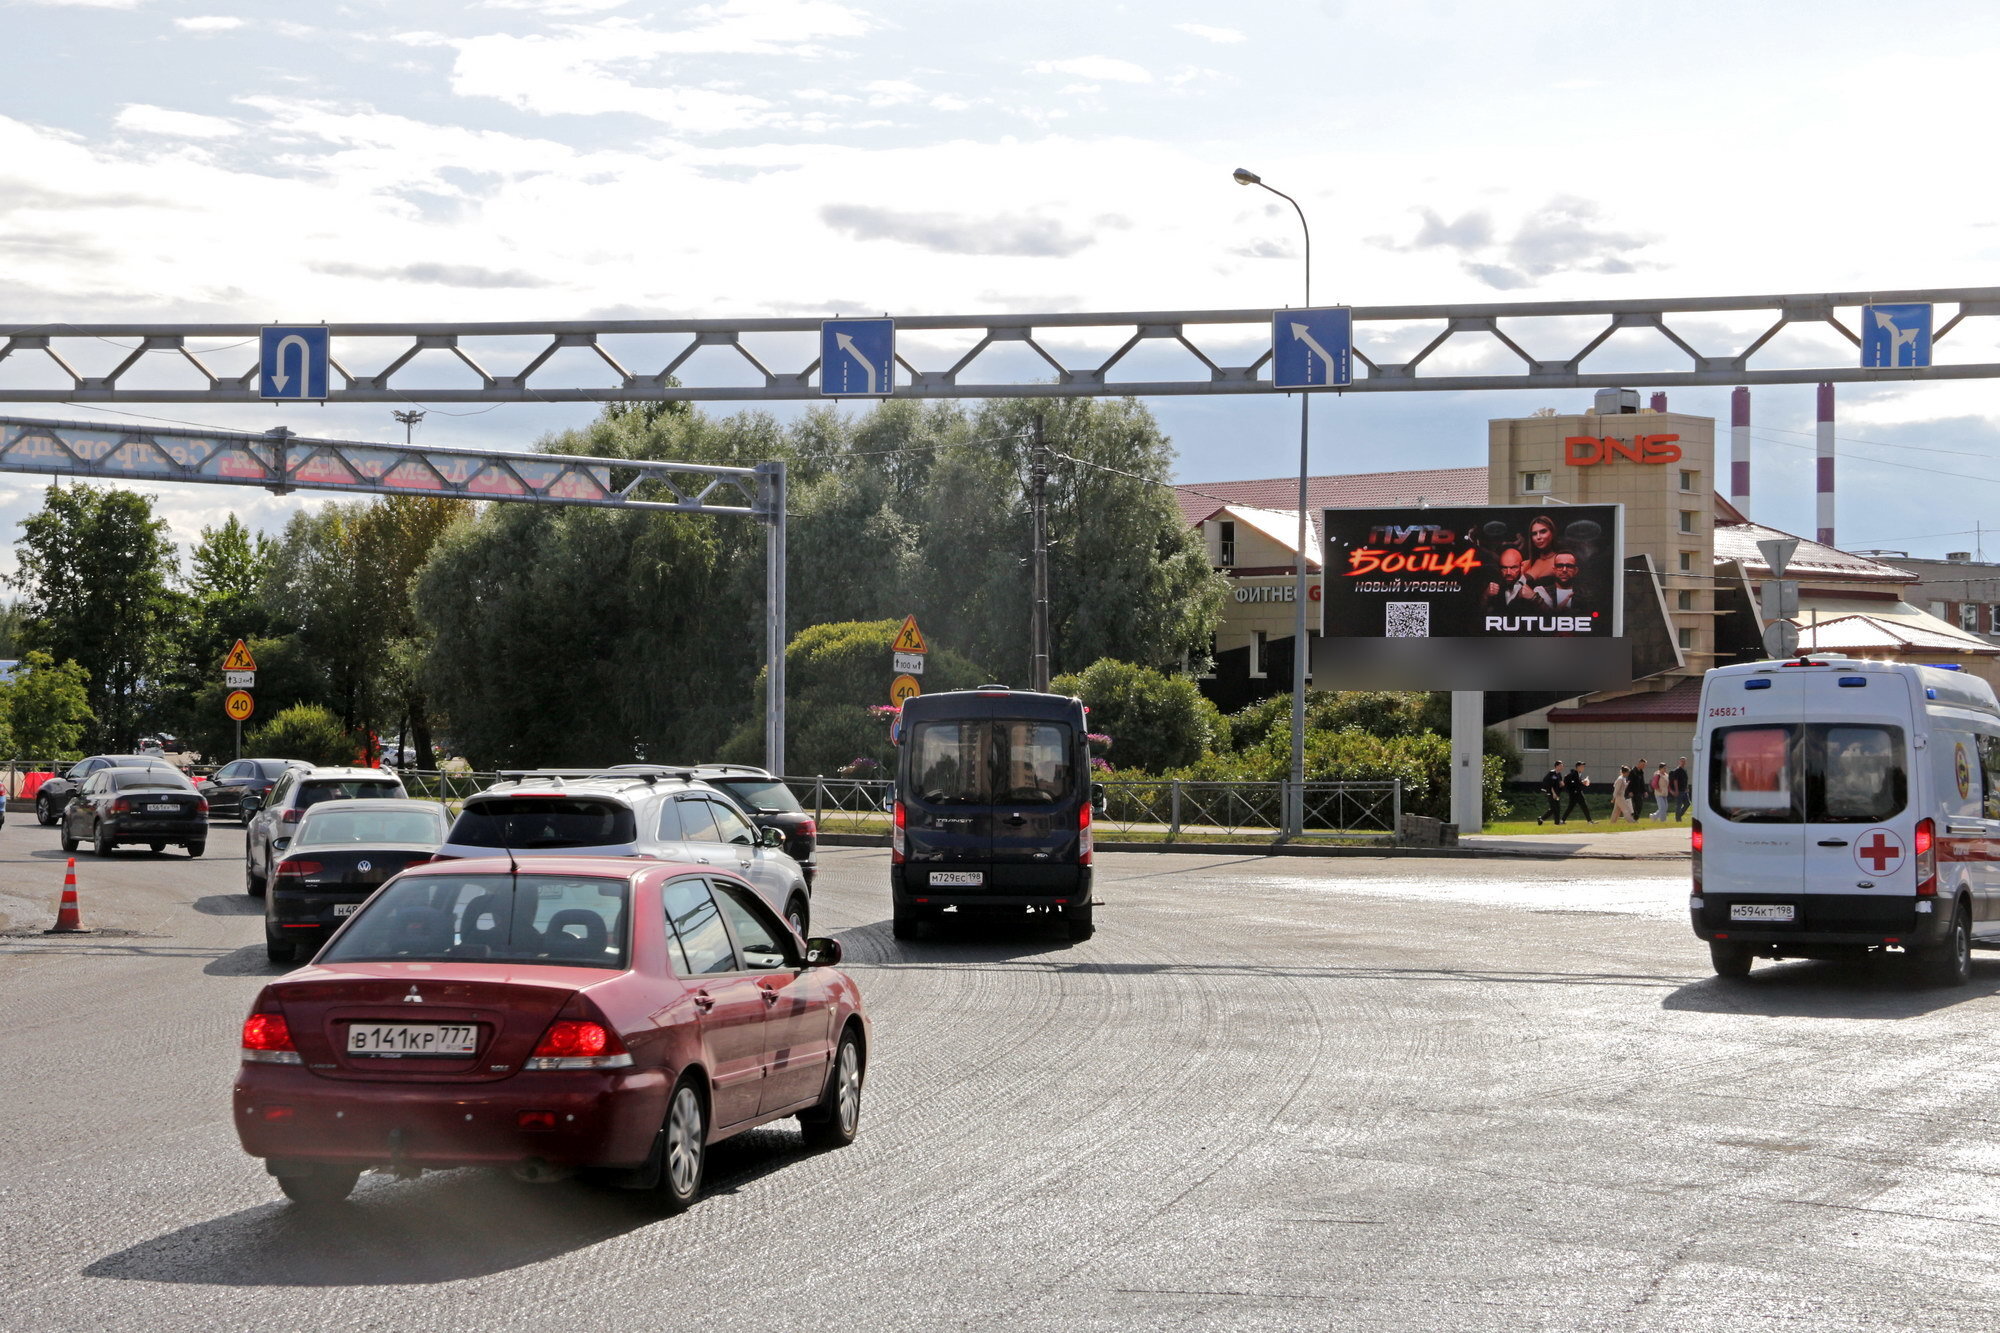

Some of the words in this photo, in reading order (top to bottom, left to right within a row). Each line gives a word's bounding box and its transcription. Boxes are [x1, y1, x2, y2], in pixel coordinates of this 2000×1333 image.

[1565, 434, 1682, 466] DNS
[1367, 524, 1456, 545] ПУТЬ
[1355, 578, 1400, 593] НОВЫЙ
[1403, 580, 1462, 593] УРОВЕНЬ
[1235, 586, 1297, 602] ФИТНЕ
[1485, 616, 1592, 632] RUTUBE
[900, 662, 911, 670] 100
[897, 687, 915, 700] 40
[231, 699, 248, 711] 40
[440, 1027, 471, 1043] 777
